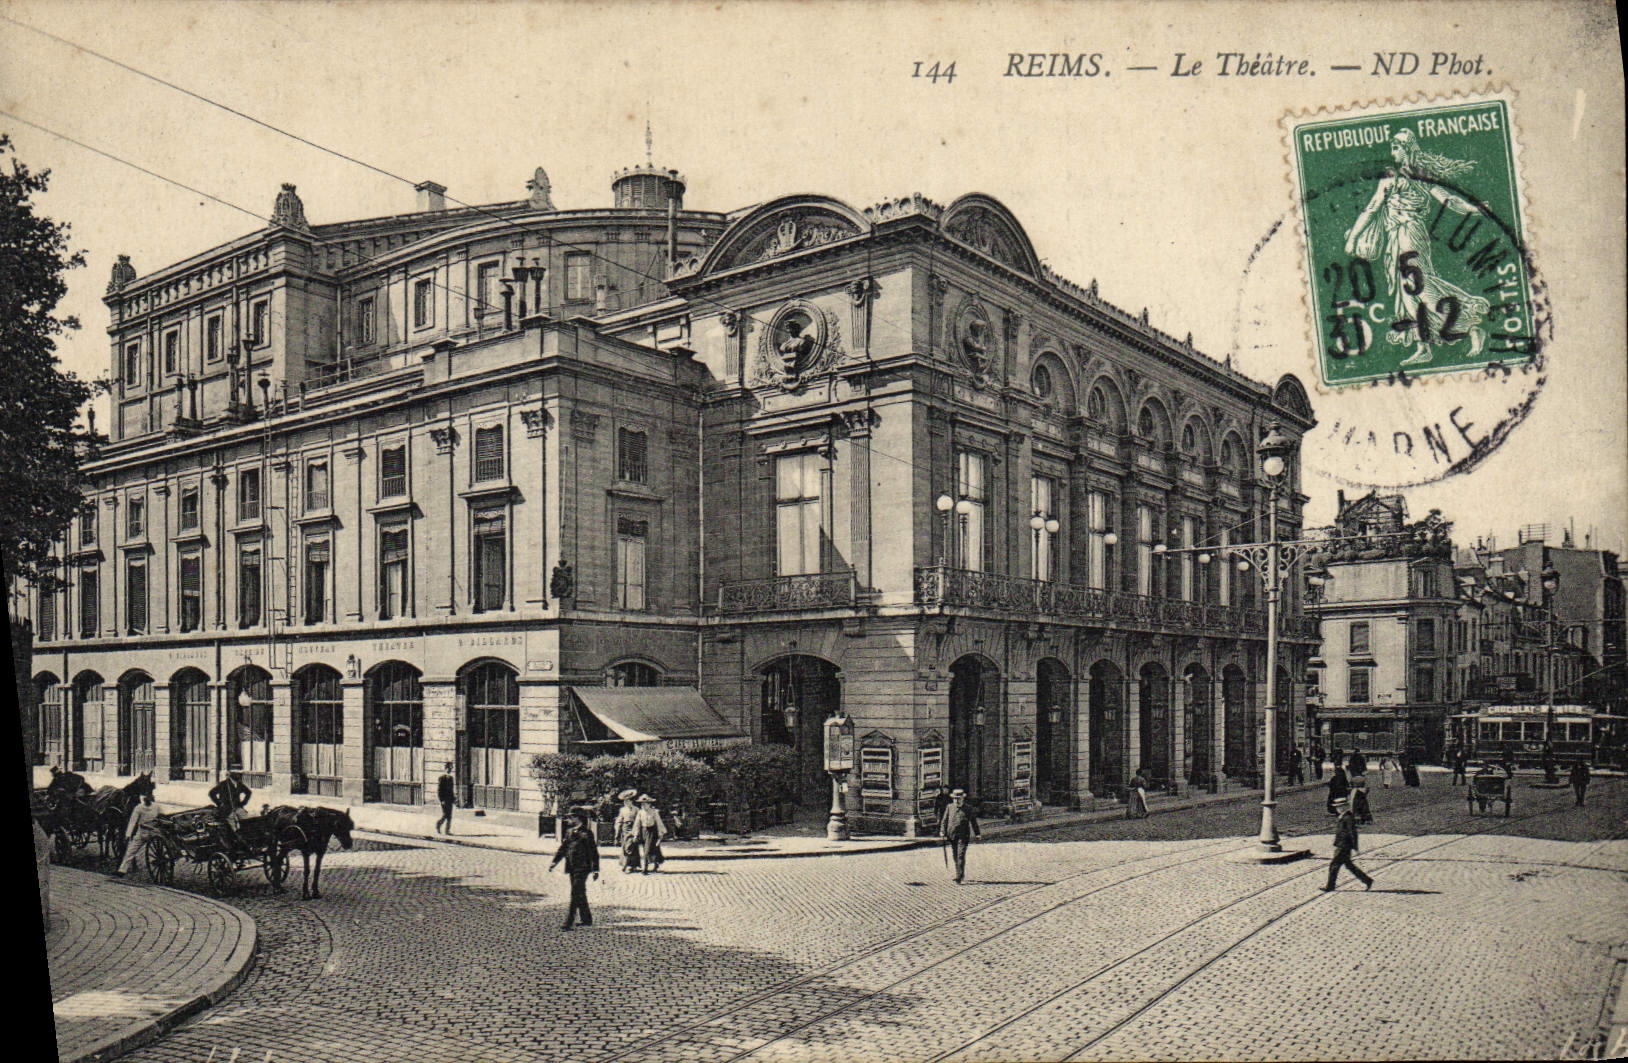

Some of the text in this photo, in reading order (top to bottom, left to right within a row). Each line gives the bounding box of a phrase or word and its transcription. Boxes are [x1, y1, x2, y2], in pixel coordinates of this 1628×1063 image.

[1304, 111, 1500, 152] REPUBLIQUE FRANÇAISE
[1500, 262, 1525, 348] POSTES
